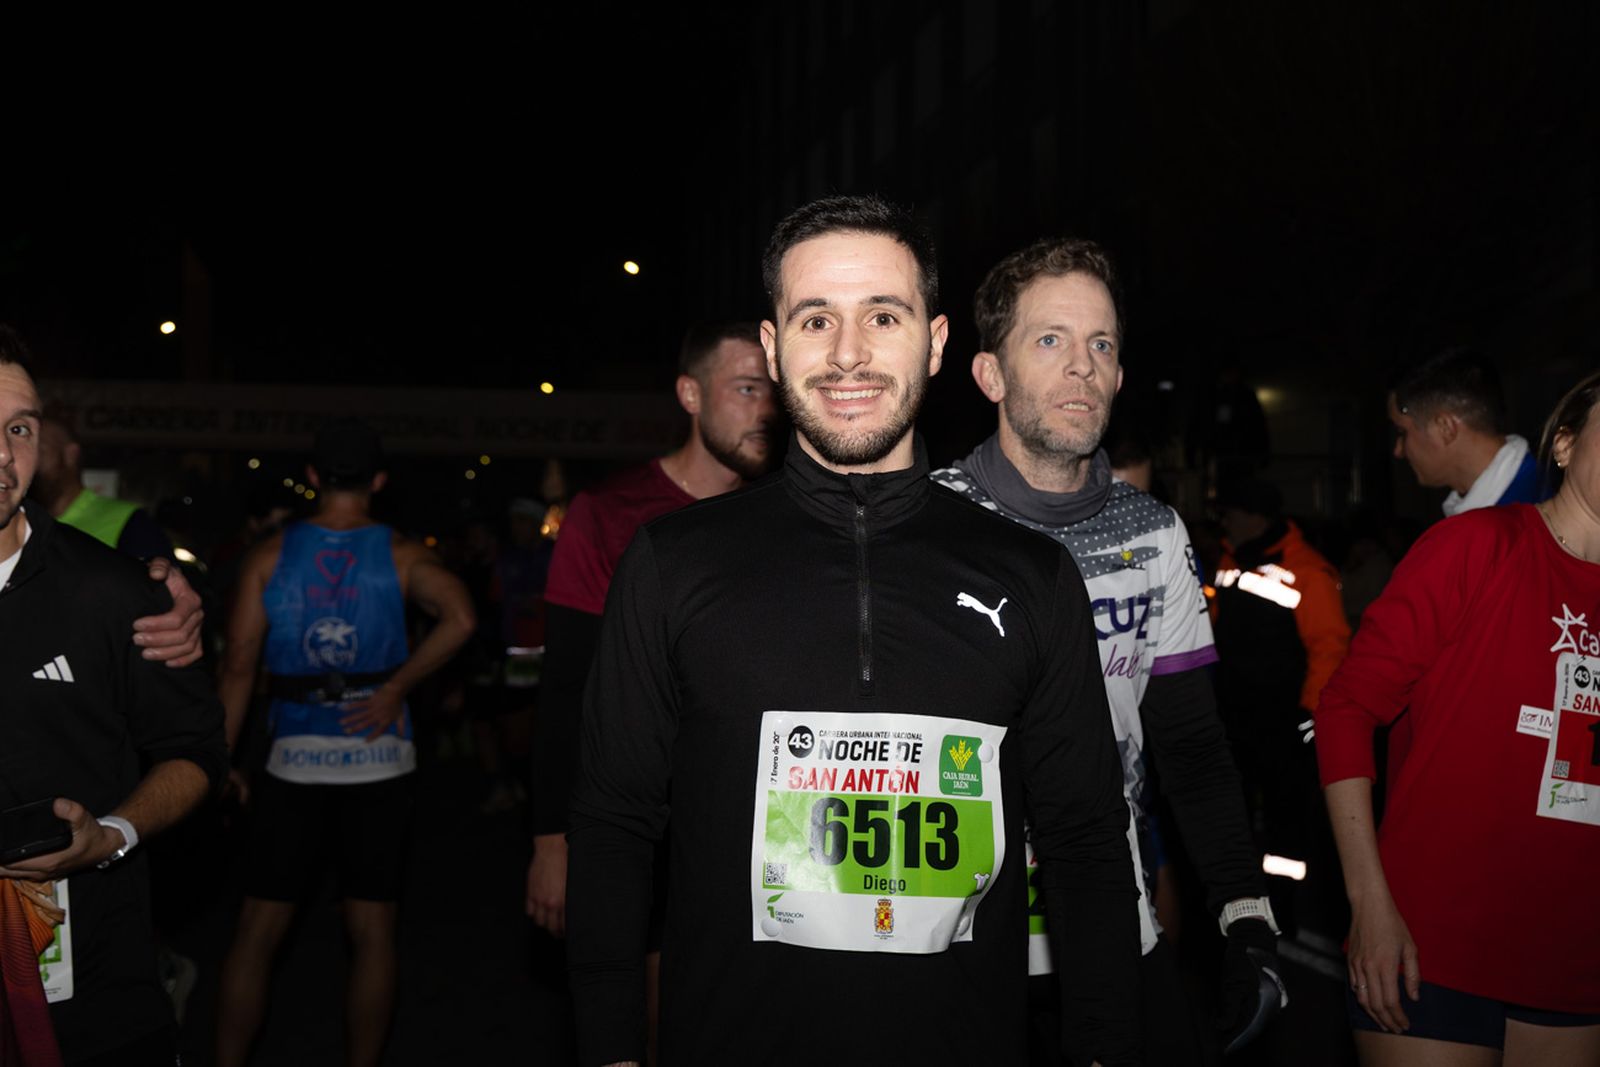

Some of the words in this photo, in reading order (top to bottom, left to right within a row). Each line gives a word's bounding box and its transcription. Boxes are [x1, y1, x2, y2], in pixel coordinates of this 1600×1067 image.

[788, 732, 814, 750] 43
[818, 739, 890, 762] NOCHE
[896, 742, 923, 764] DE
[788, 766, 838, 792] SAN
[841, 765, 920, 794] ANTÓN
[809, 797, 960, 872] 6513
[863, 874, 906, 894] Diego
